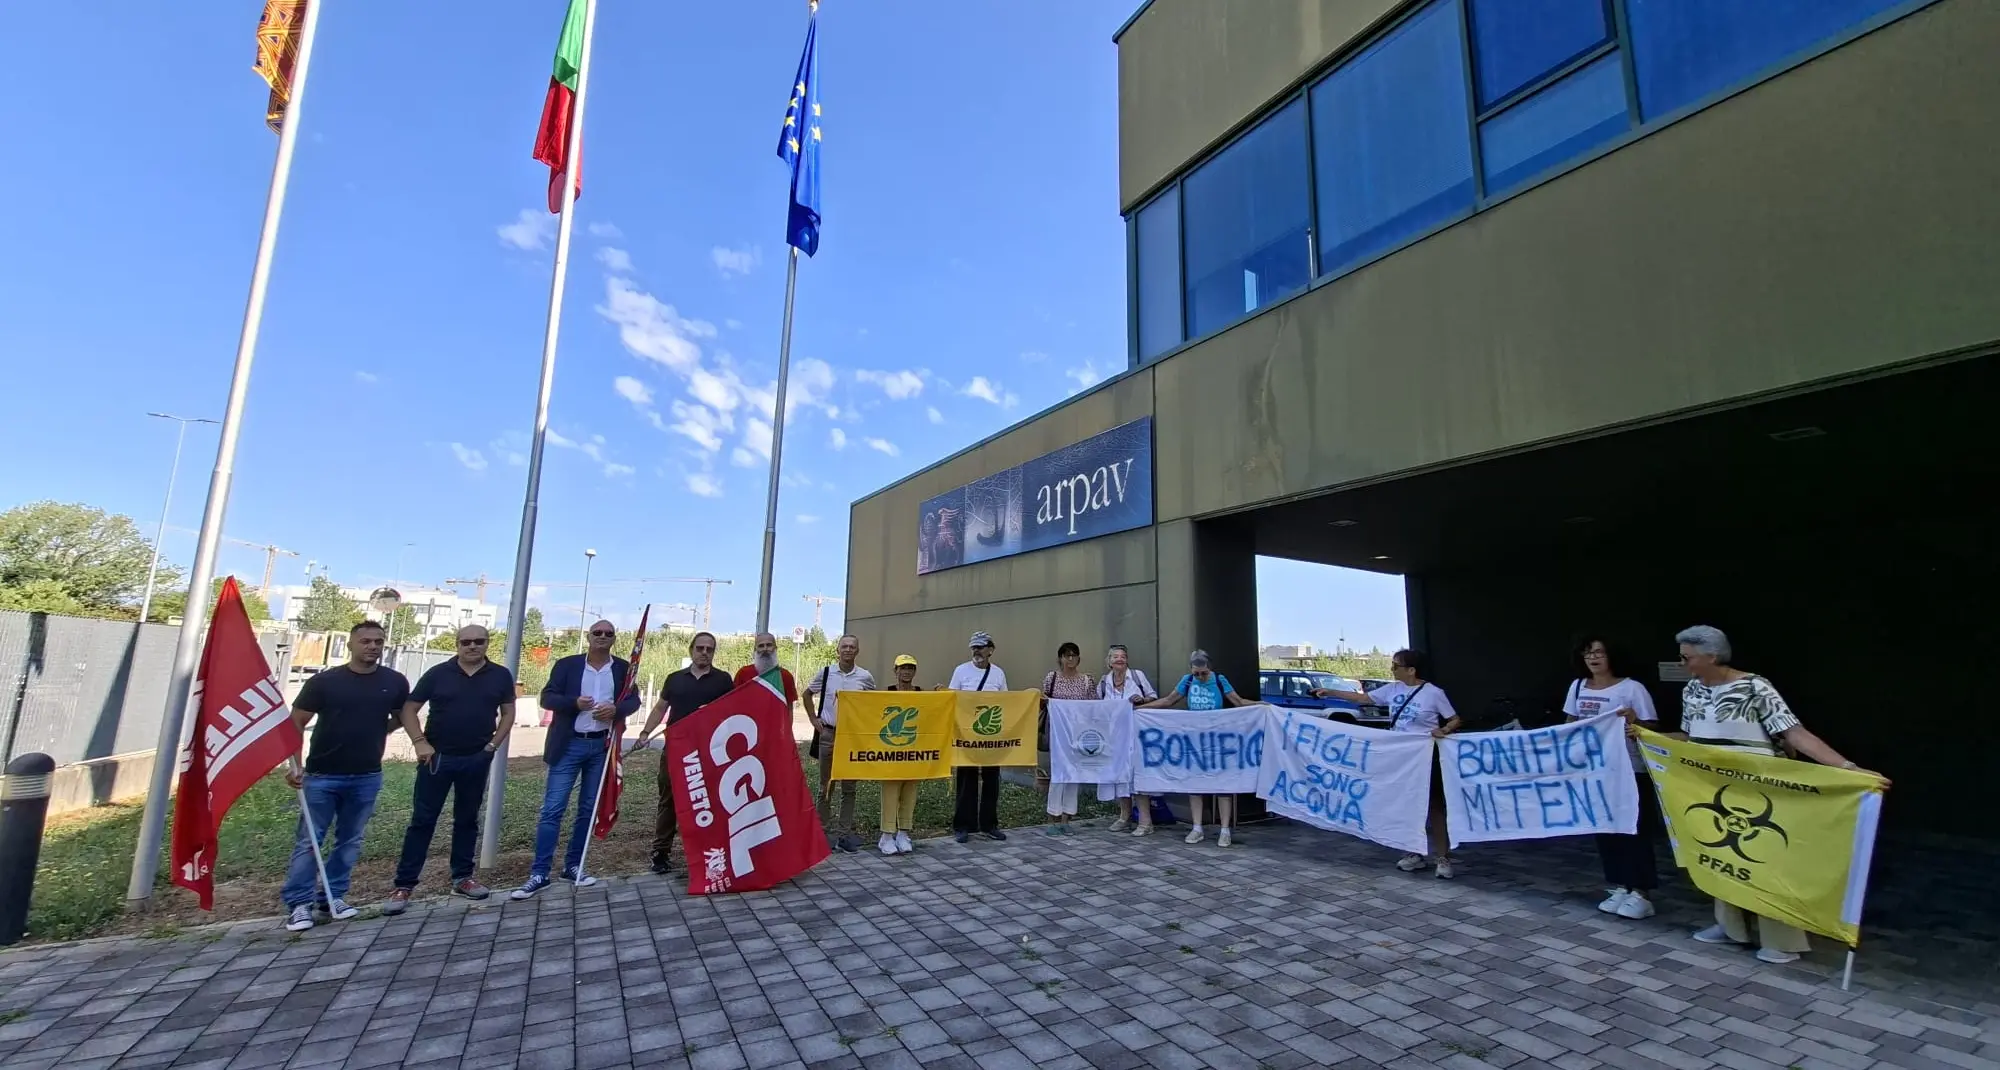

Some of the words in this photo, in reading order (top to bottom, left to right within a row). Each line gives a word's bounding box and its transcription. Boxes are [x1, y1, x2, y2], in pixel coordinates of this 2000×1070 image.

[1036, 458, 1133, 535] arpav
[849, 750, 940, 762] LEGAMBIENTE
[1294, 723, 1371, 773] FIGLI
[1457, 725, 1605, 779] BONIFICA
[682, 750, 714, 828] VENETO
[709, 714, 782, 878] CGIL
[1269, 770, 1364, 831] ACQUA
[1306, 764, 1369, 800] SONO
[1680, 757, 1713, 773] ZONA
[1715, 767, 1822, 796] CONTAMINATA
[1461, 778, 1613, 832] MITENI
[1698, 853, 1751, 881] PFAS
